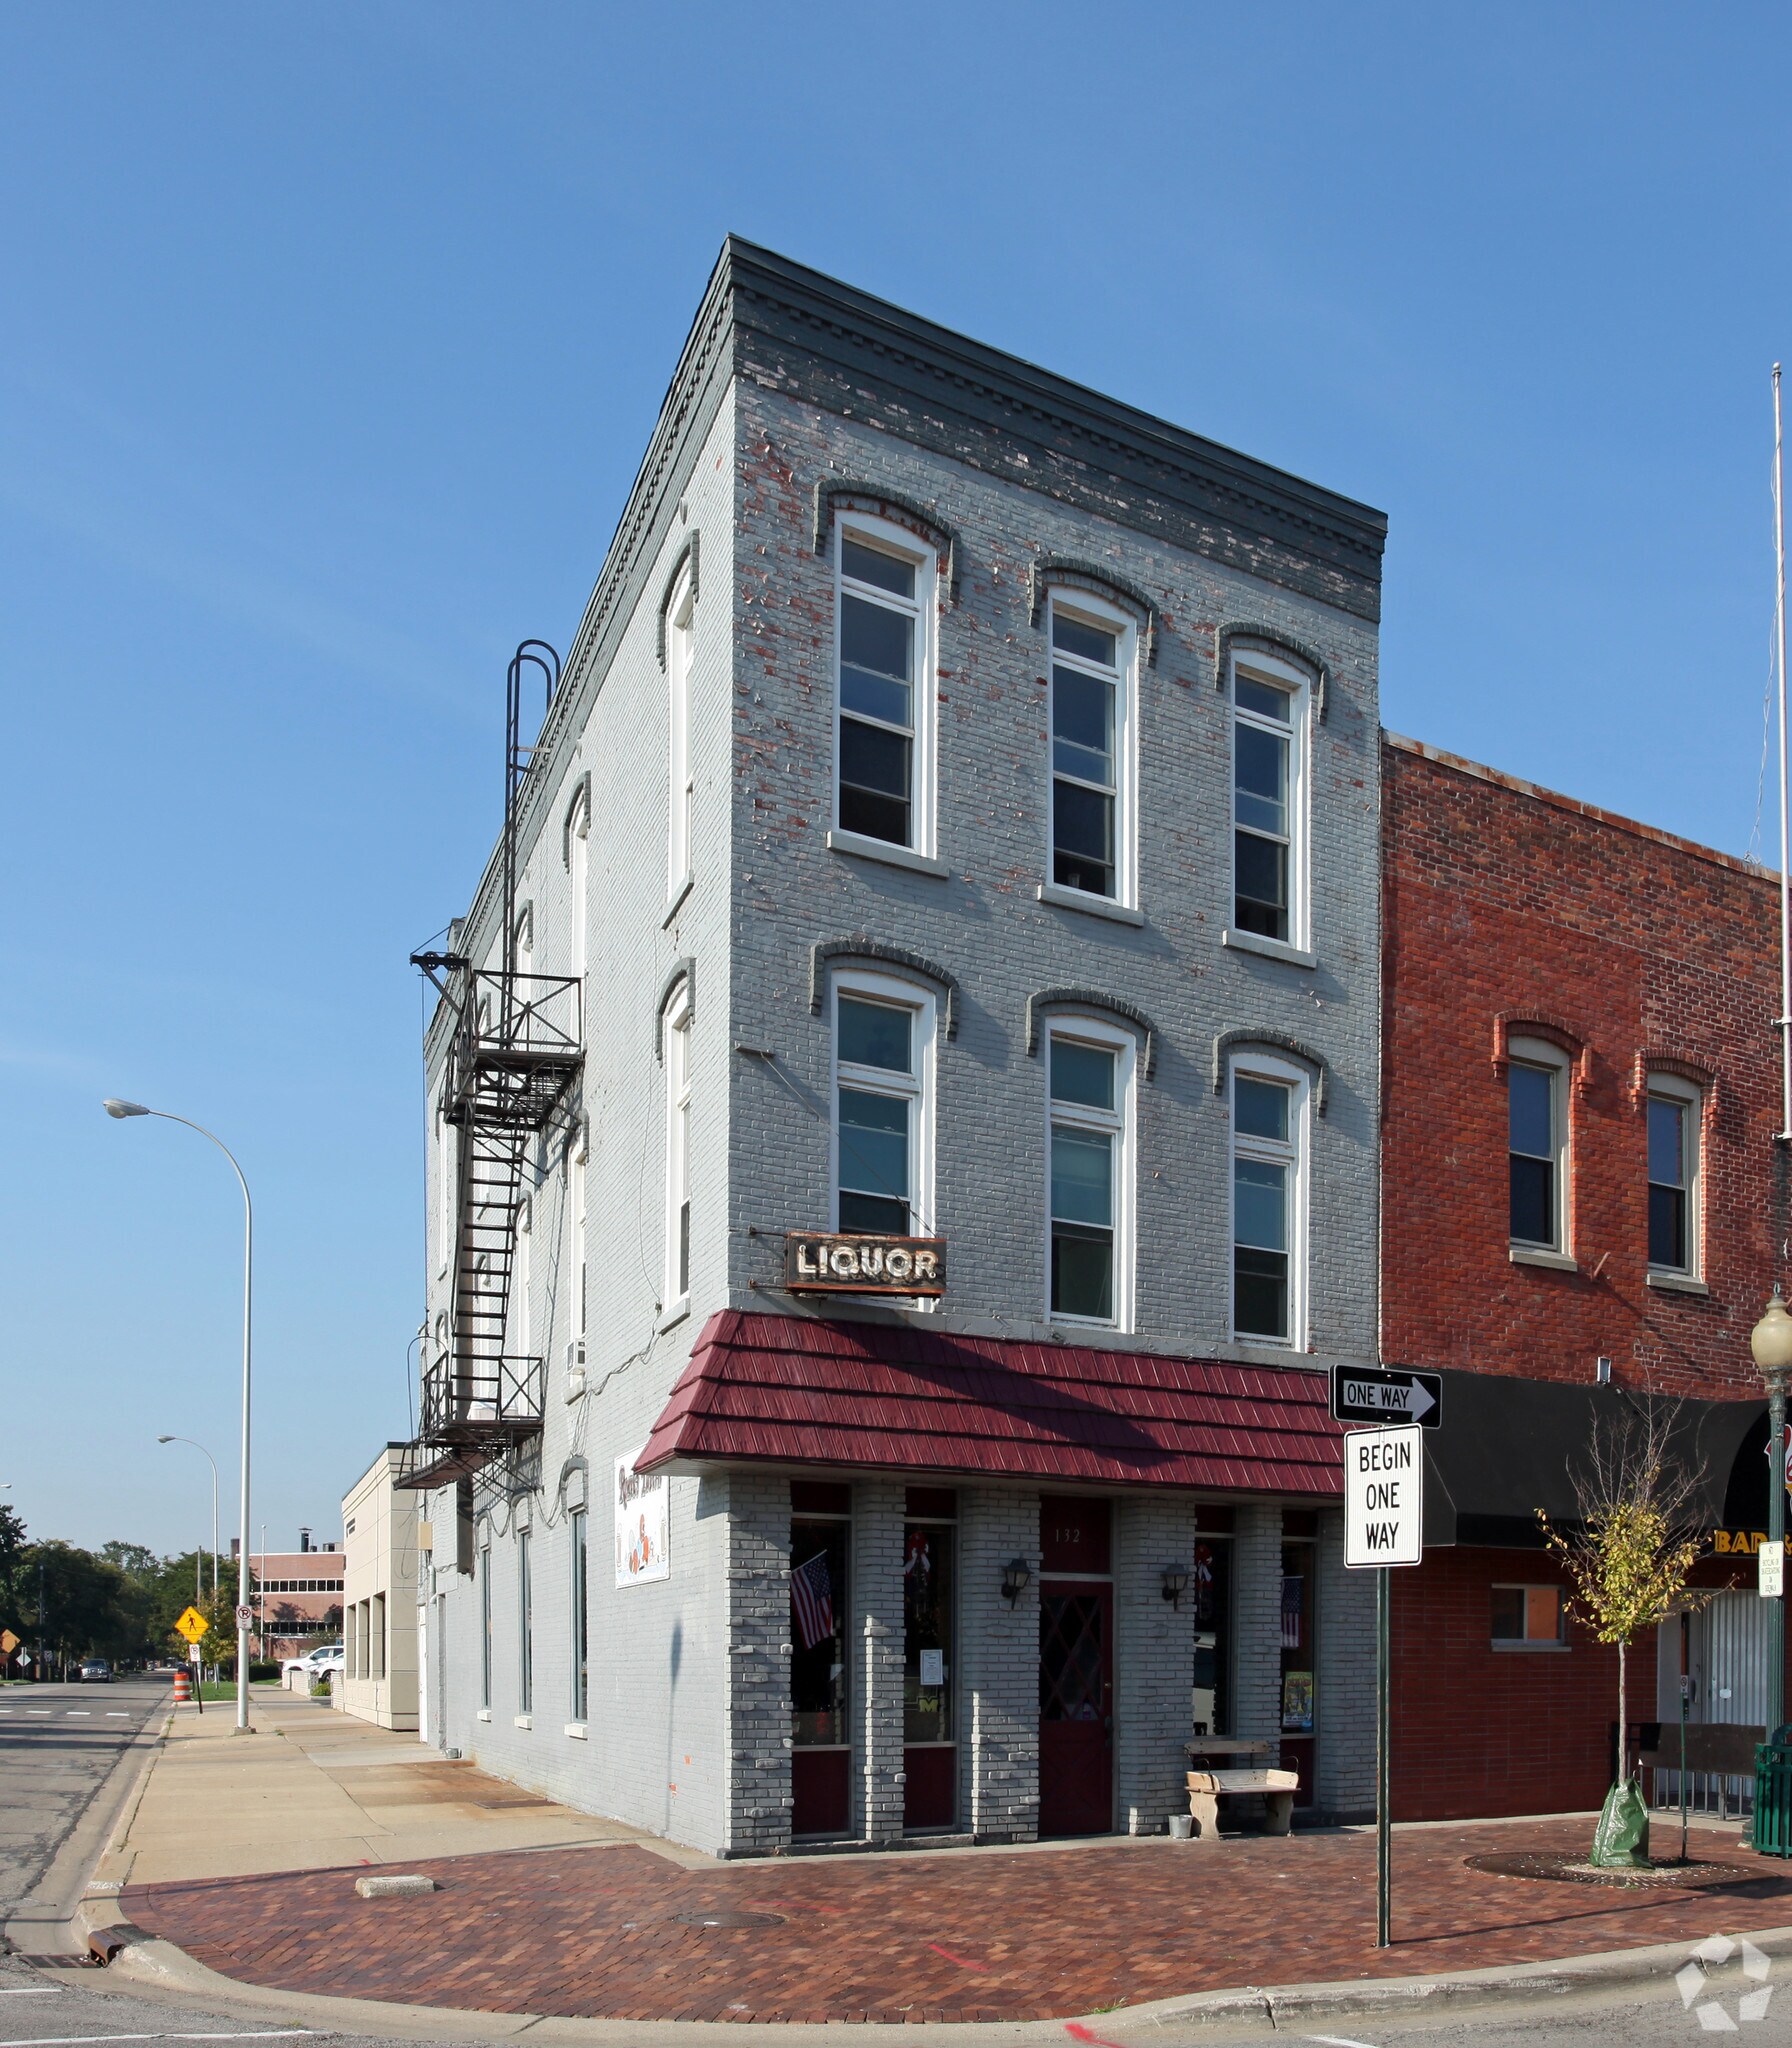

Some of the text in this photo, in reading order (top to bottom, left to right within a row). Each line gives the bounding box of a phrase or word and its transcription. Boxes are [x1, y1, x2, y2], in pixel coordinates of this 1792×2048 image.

[798, 1244, 939, 1279] LIQUOR
[1347, 1383, 1410, 1408] ONE WAY
[1359, 1441, 1411, 1473] BEGIN
[1366, 1482, 1400, 1511] ONE
[1055, 1528, 1081, 1543] 132
[1366, 1522, 1400, 1550] WAY
[919, 1698, 939, 1713] M
